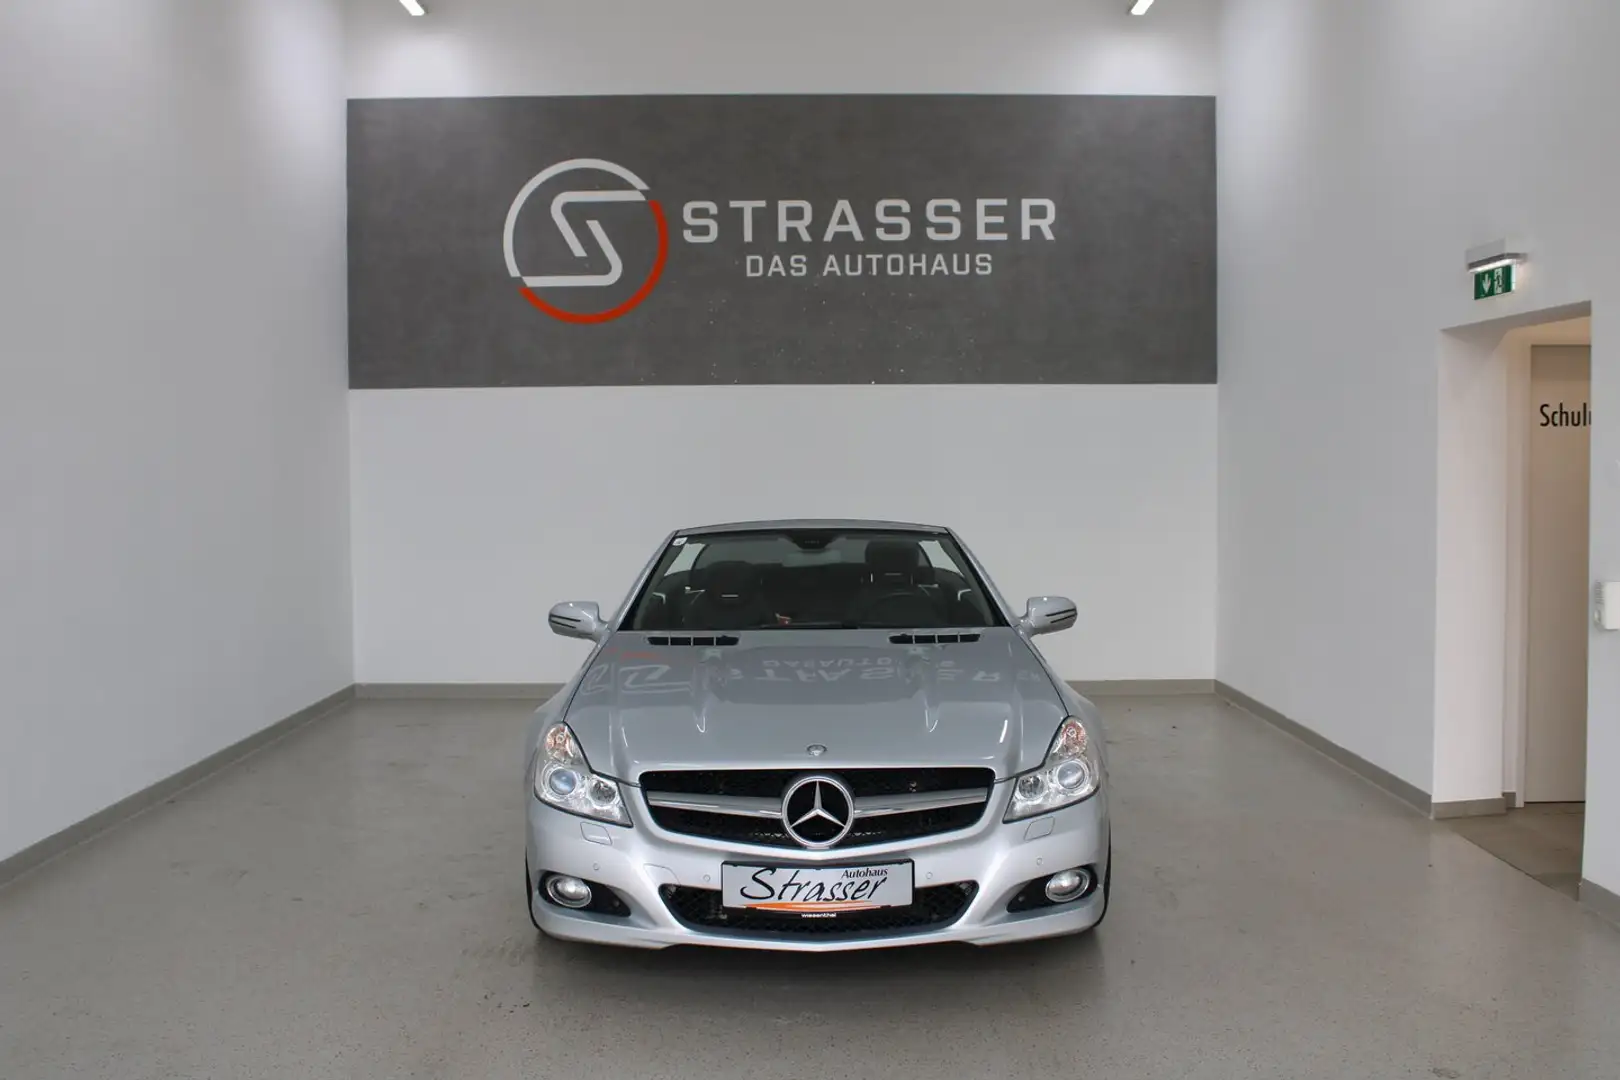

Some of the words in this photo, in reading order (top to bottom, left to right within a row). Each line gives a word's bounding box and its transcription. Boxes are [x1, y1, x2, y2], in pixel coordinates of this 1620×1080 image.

[682, 197, 1057, 244] STRASSER
[745, 254, 808, 278] DAS
[822, 253, 993, 277] AUTOHAUS
[1539, 402, 1592, 427] Schul
[740, 867, 888, 902] Strasser
[841, 867, 888, 879] Autohaus
